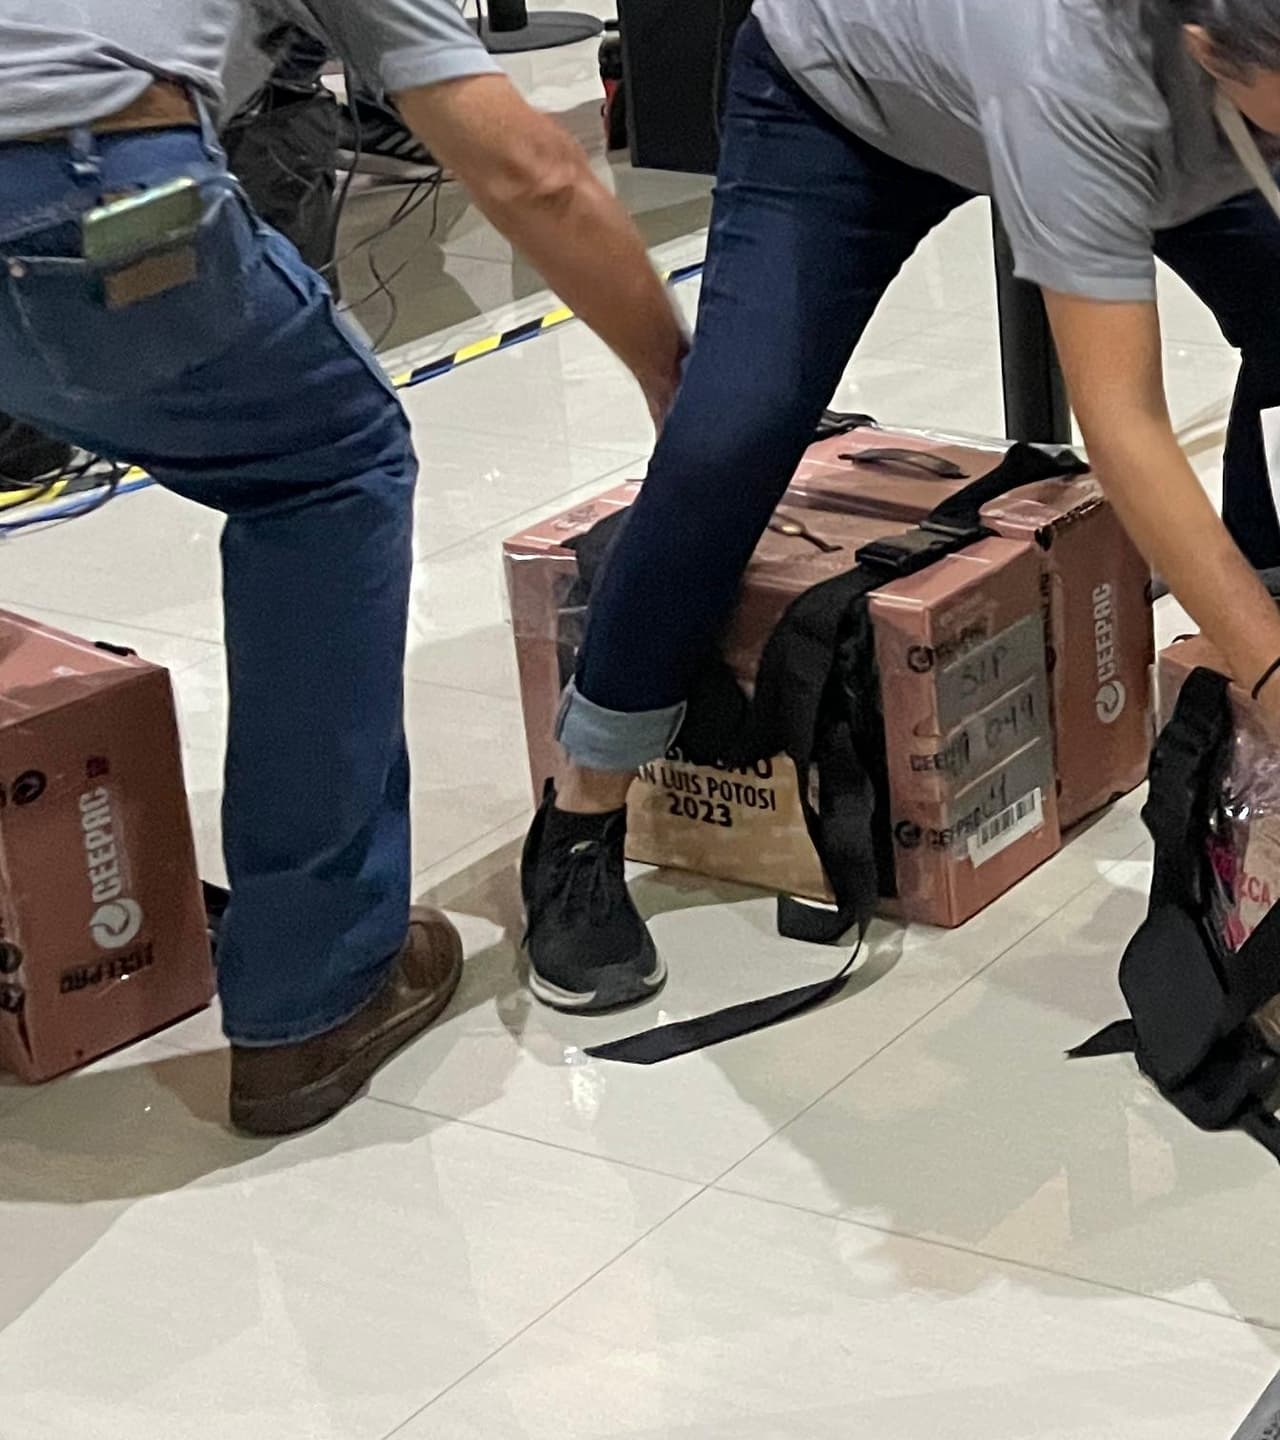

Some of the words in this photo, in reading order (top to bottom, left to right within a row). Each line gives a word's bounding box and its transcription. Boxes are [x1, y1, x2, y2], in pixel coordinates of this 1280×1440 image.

[1092, 583, 1116, 682] CEEPAC
[660, 766, 702, 796] LUIS
[706, 776, 776, 812] POTOSI
[668, 792, 733, 828] 2023
[79, 785, 122, 904] CEEPAC
